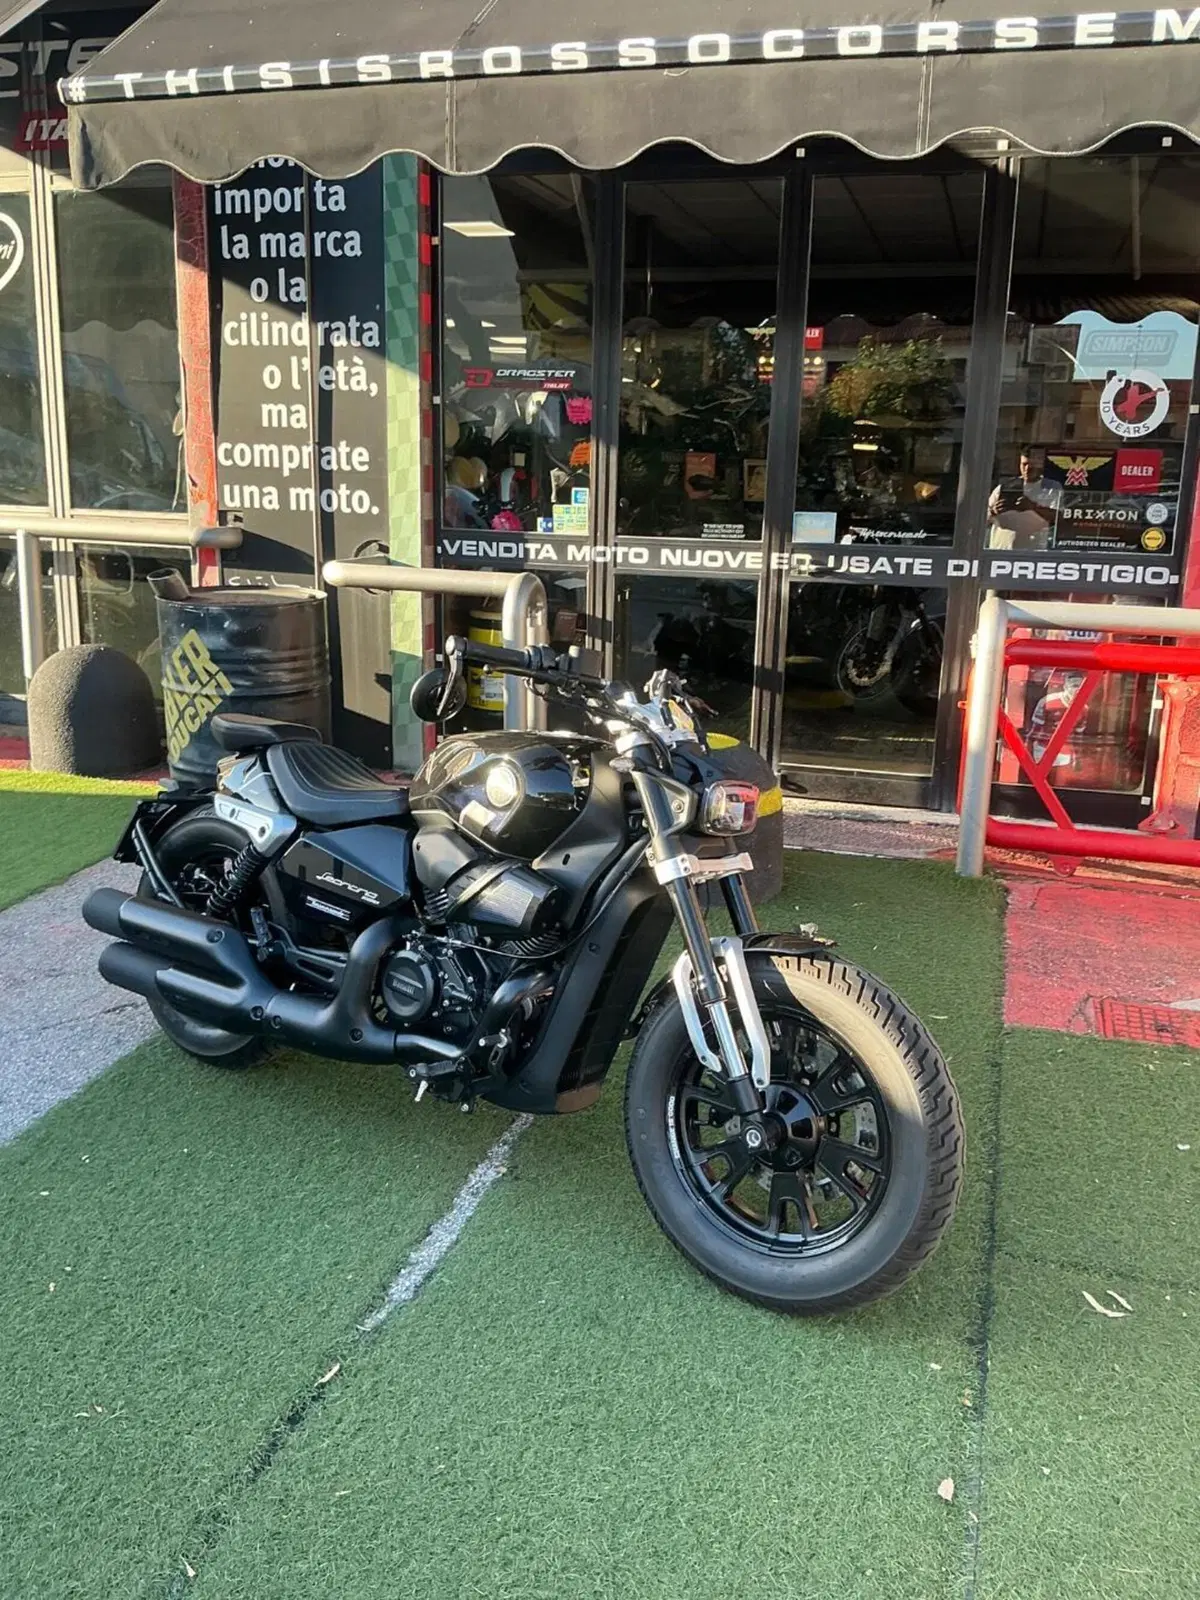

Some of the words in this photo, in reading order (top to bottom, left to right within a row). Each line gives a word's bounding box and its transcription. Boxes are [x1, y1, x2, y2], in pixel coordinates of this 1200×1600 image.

[213, 179, 347, 223] importa
[220, 224, 251, 260] la
[259, 229, 363, 259] marca
[250, 276, 270, 303] o
[278, 268, 308, 303] la
[223, 312, 381, 348] cilindrata
[1090, 334, 1170, 353] SIMPSON
[262, 363, 282, 391] o
[291, 356, 379, 397] l'età,
[496, 368, 577, 379] DRAGSTER
[261, 402, 308, 429] ma
[1108, 415, 1151, 436] YEARS
[217, 441, 370, 478] comprate
[1121, 464, 1155, 477] DEALER
[223, 483, 280, 511] una
[288, 483, 380, 515] moto.
[1062, 507, 1139, 521] BRIXTON
[566, 544, 650, 564] MOTO
[660, 548, 763, 570] NUOVE
[827, 554, 934, 577] USATE
[947, 558, 979, 578] DI
[1099, 541, 1126, 549] DEALER
